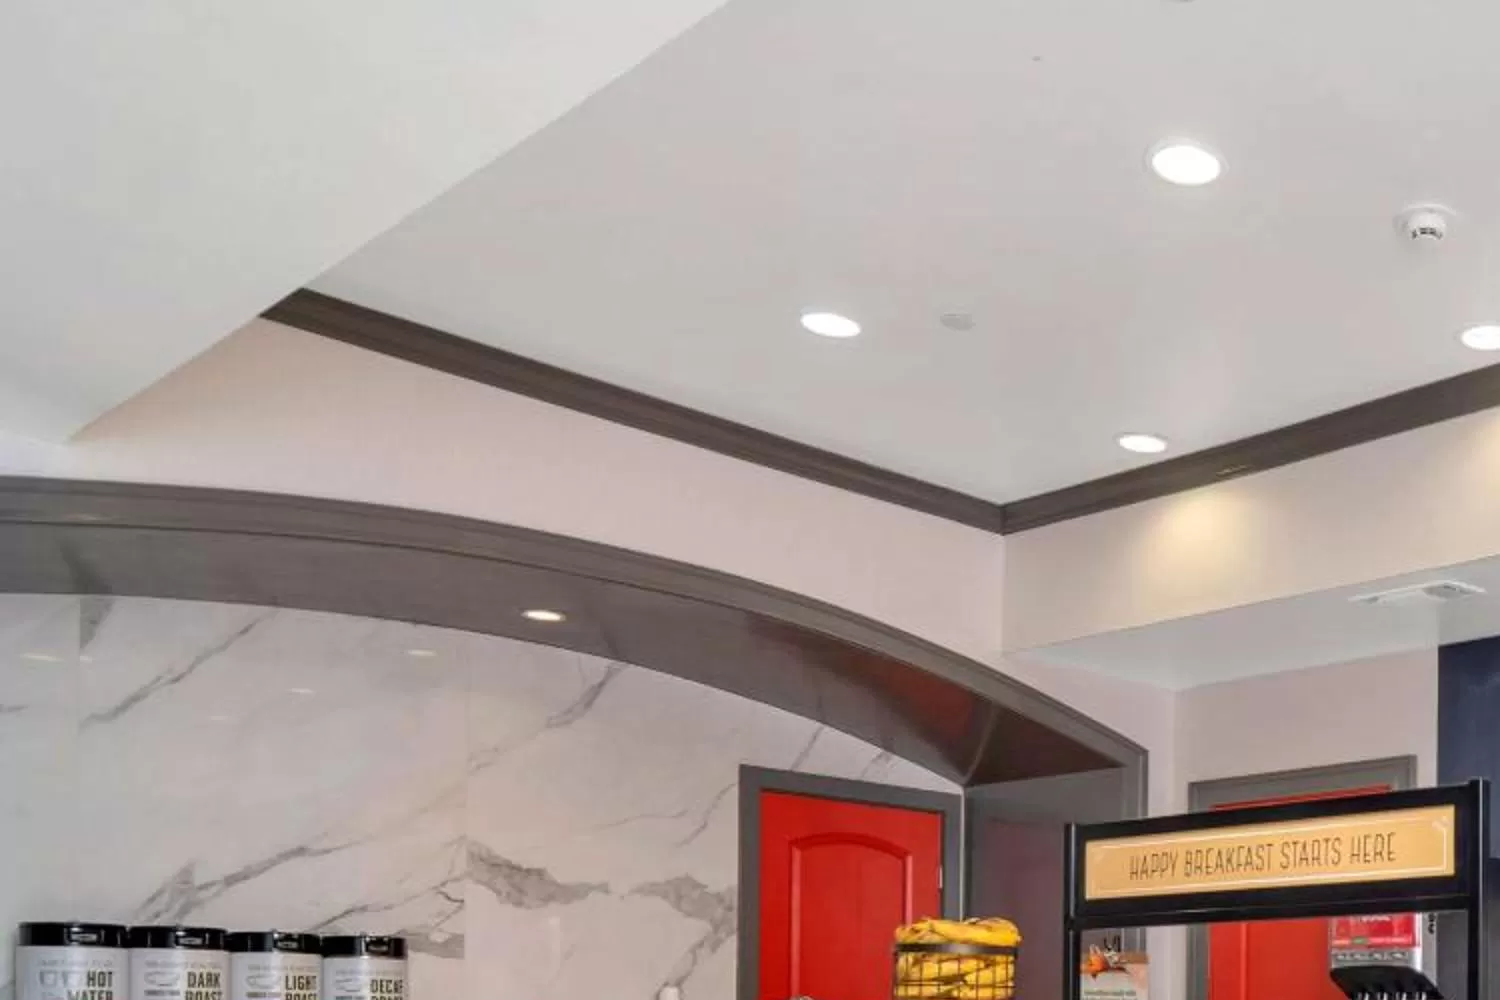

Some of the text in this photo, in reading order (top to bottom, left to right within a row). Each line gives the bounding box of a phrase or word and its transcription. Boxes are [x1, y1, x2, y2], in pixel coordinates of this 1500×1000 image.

[1129, 831, 1397, 881] HAPPY BREAKFAST STARTS HERE
[87, 971, 113, 988] HOT
[187, 971, 221, 988] DARK
[285, 975, 317, 991] LIGHT
